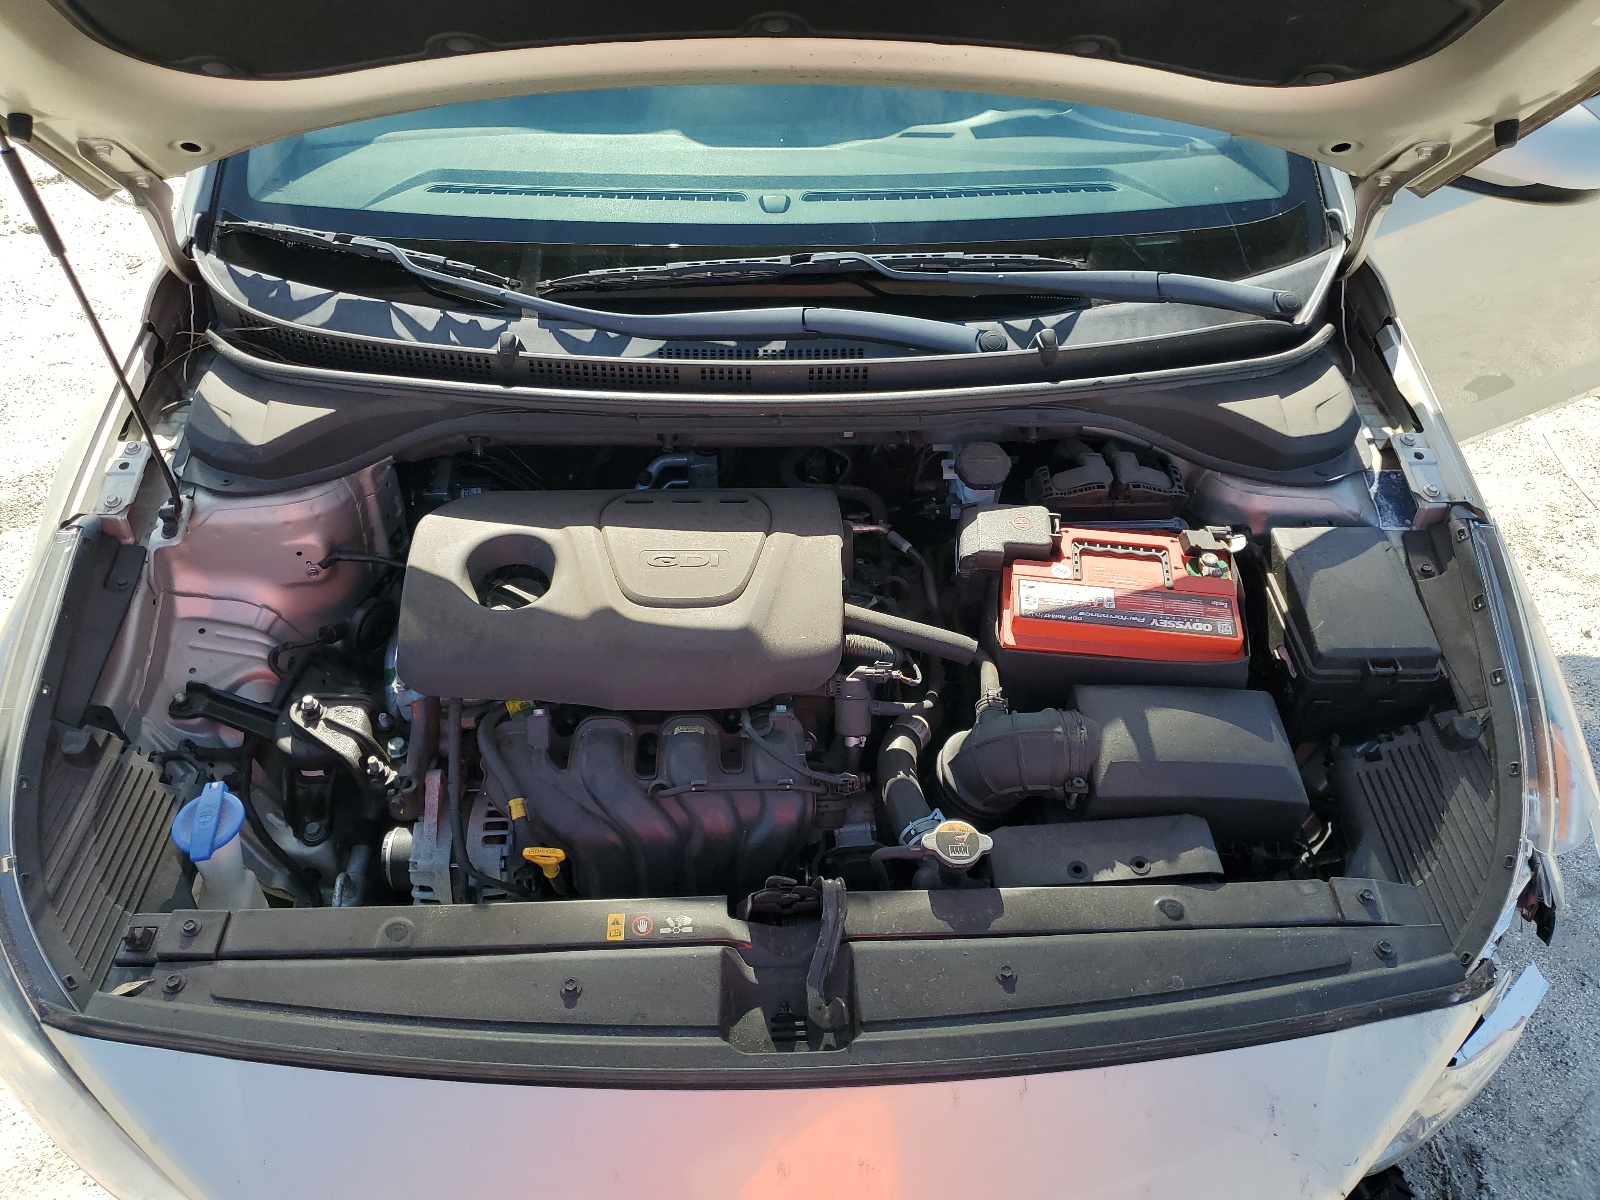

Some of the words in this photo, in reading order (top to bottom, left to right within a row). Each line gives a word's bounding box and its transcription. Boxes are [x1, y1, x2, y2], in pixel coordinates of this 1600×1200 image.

[647, 553, 720, 568] GDI
[1078, 611, 1145, 623] Performance
[1149, 618, 1212, 632] ODYSSEY
